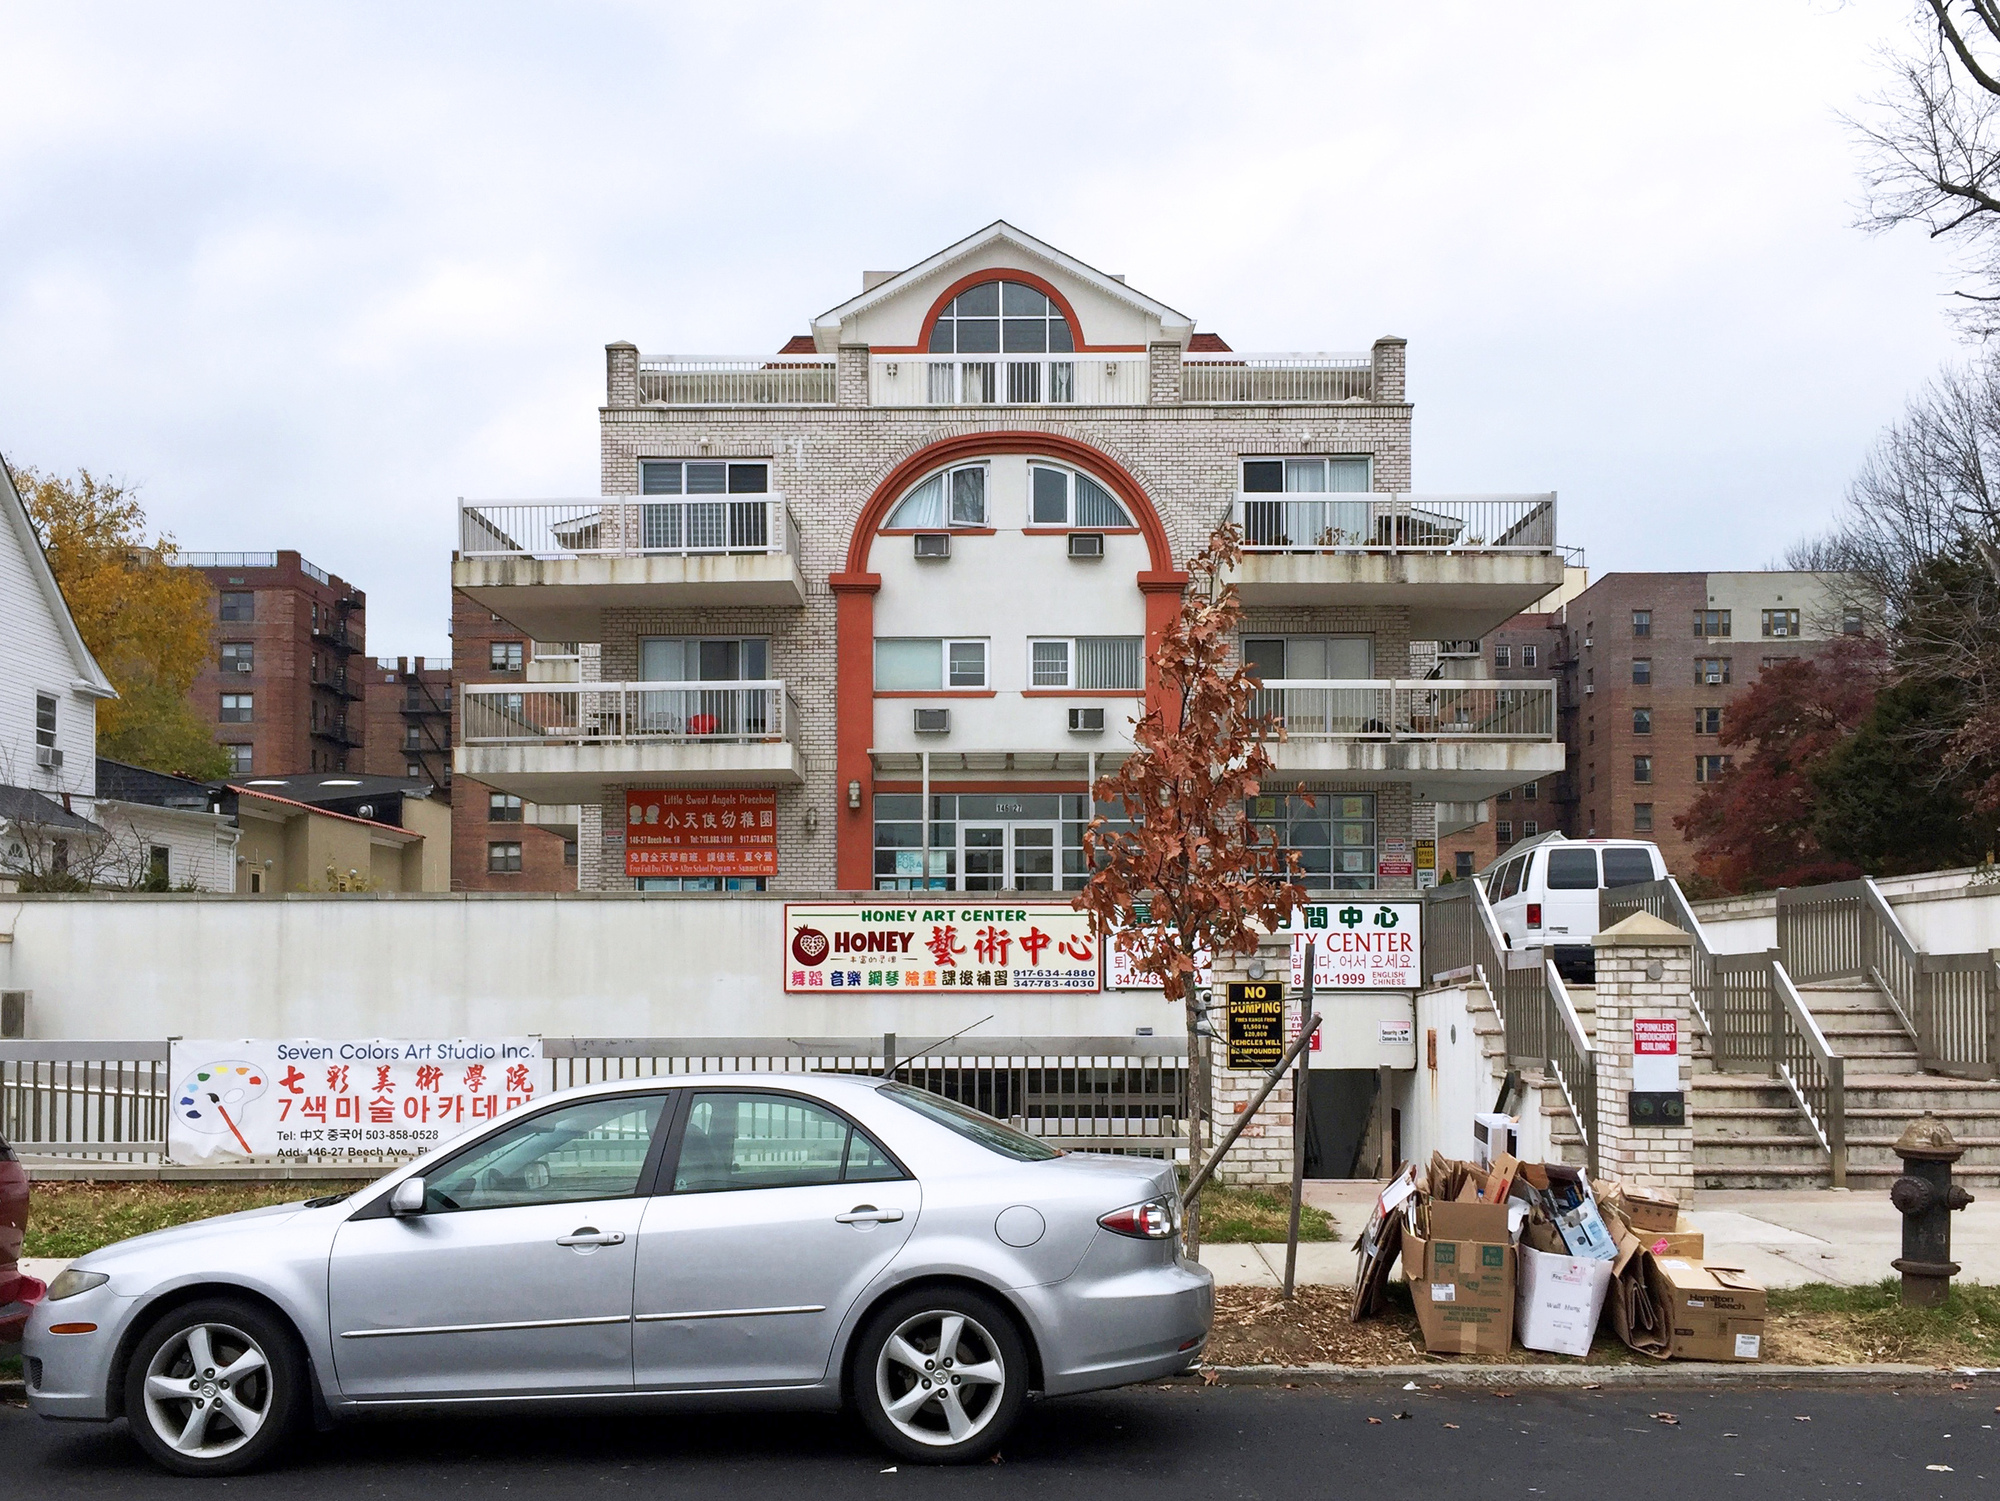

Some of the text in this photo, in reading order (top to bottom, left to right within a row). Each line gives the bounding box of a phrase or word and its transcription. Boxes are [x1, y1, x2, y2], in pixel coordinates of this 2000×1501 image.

[664, 794, 683, 805] Little
[712, 794, 736, 807] Angels
[740, 794, 774, 804] Preschool
[664, 810, 773, 829] 小天使幼稚園
[861, 910, 1027, 922] HONEY ART CENTER
[834, 931, 915, 953] HONEY
[924, 925, 1094, 967] 藝術中心
[1326, 932, 1414, 953] CENTER
[791, 970, 823, 987] 舞蹈
[830, 970, 861, 987] 音樂
[868, 970, 899, 987] 鋼琴
[942, 970, 1008, 986] 課後補習
[1013, 969, 1096, 977] 917-634-4880
[1372, 971, 1406, 979] ENGLISH/
[1372, 978, 1407, 986] CHINESE
[1244, 986, 1266, 999] NO
[1230, 1001, 1281, 1014] DUMPING
[1636, 1023, 1675, 1032] SPRINKLERS
[1635, 1033, 1676, 1041] THROUGHOUT
[278, 1043, 535, 1060] Seven Colors Art Studio Inc.
[1641, 1042, 1670, 1051] BUILDING
[278, 1064, 534, 1094] 七彩美術學院
[277, 1129, 438, 1141] Tel: 中文 중국어 503-858-0528
[277, 1147, 303, 1157] Add:
[307, 1147, 344, 1157] 146-27
[347, 1146, 383, 1156] Beech
[1690, 1294, 1734, 1303] Hamilton
[1714, 1302, 1746, 1310] Beach
